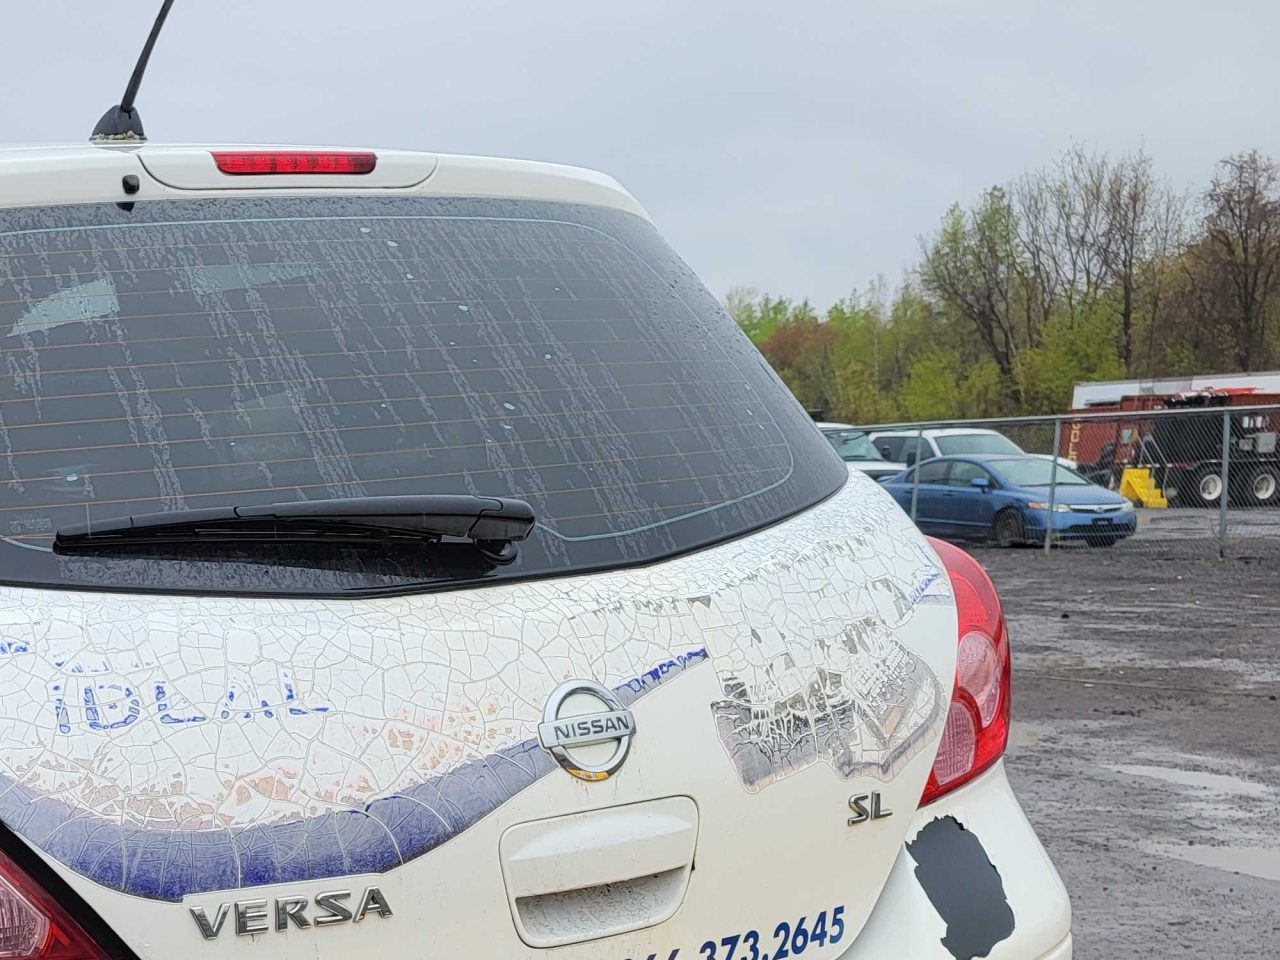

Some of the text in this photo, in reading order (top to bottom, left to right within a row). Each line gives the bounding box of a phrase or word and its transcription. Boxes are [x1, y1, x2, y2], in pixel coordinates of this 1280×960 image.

[554, 713, 632, 742] NISSAN
[848, 790, 894, 827] SL
[188, 886, 395, 941] VERSA
